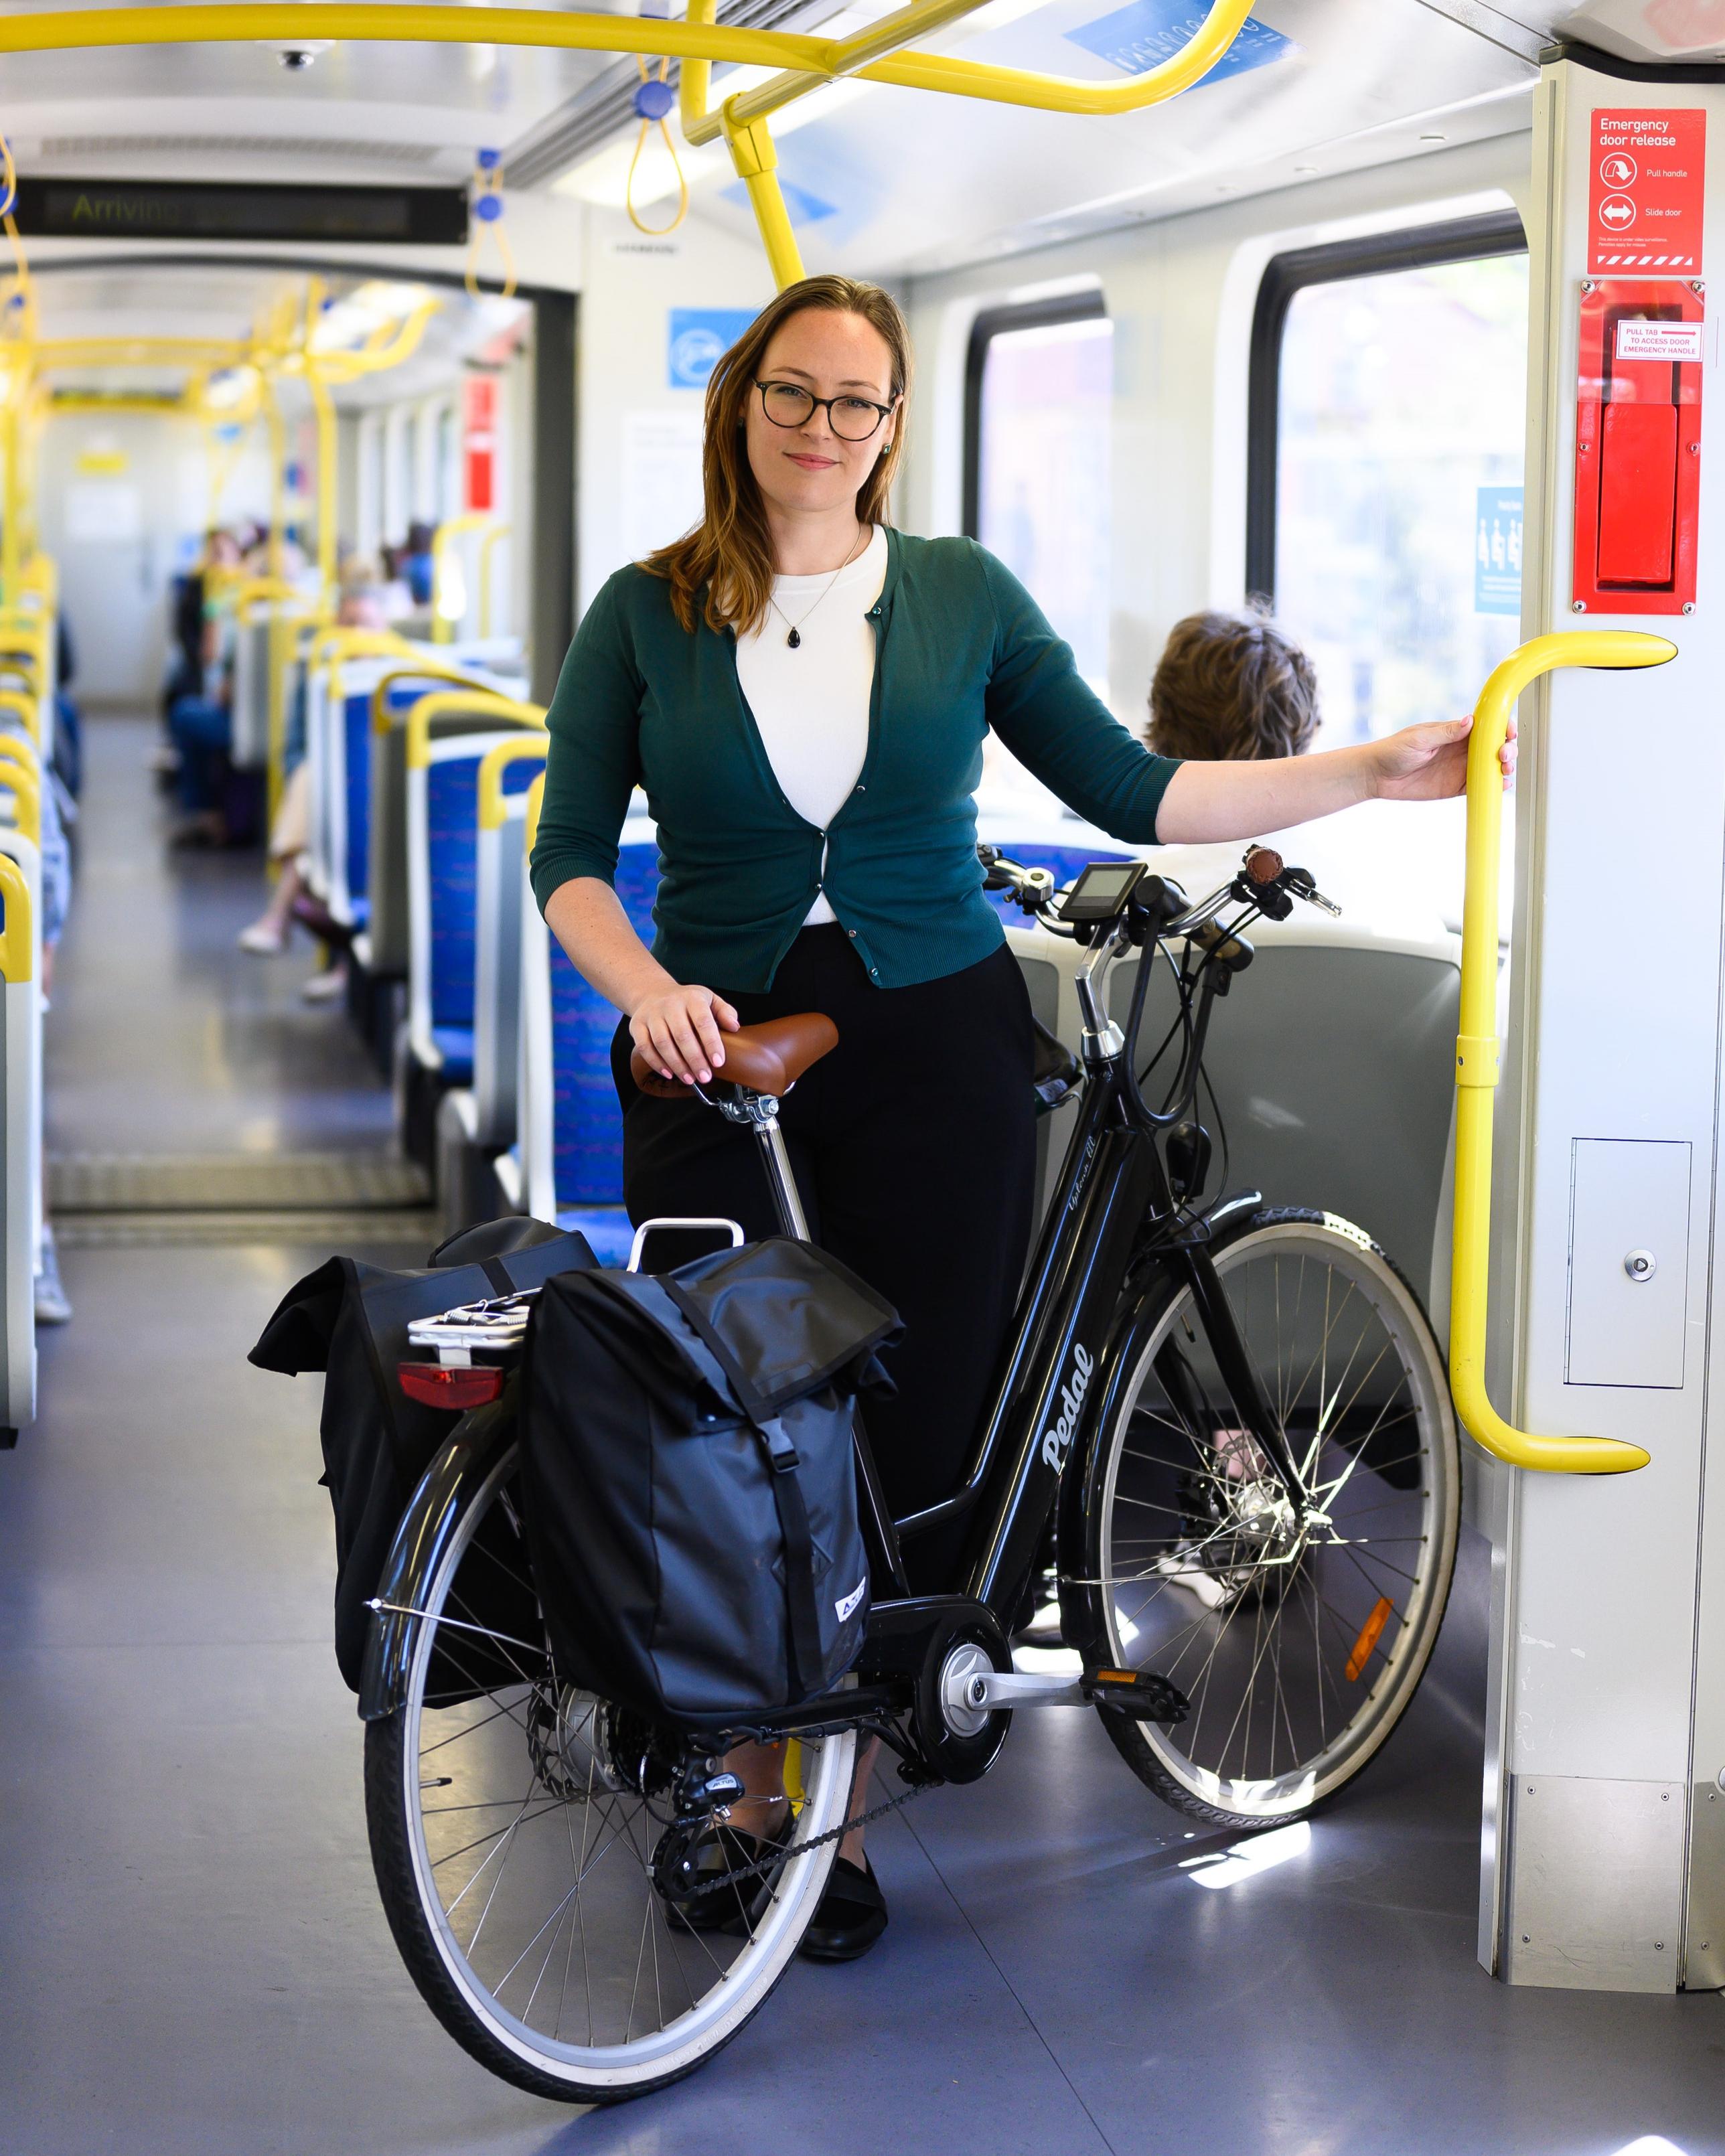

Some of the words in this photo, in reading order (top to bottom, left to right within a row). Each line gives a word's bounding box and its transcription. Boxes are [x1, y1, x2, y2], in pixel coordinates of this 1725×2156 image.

[1600, 119, 1669, 133] Emergency
[1600, 135, 1627, 146] door
[1631, 135, 1675, 146] release
[1647, 169, 1661, 177] Pull
[1042, 1342, 1094, 1476] Pedal
[712, 1780, 734, 1788] ALTUS
